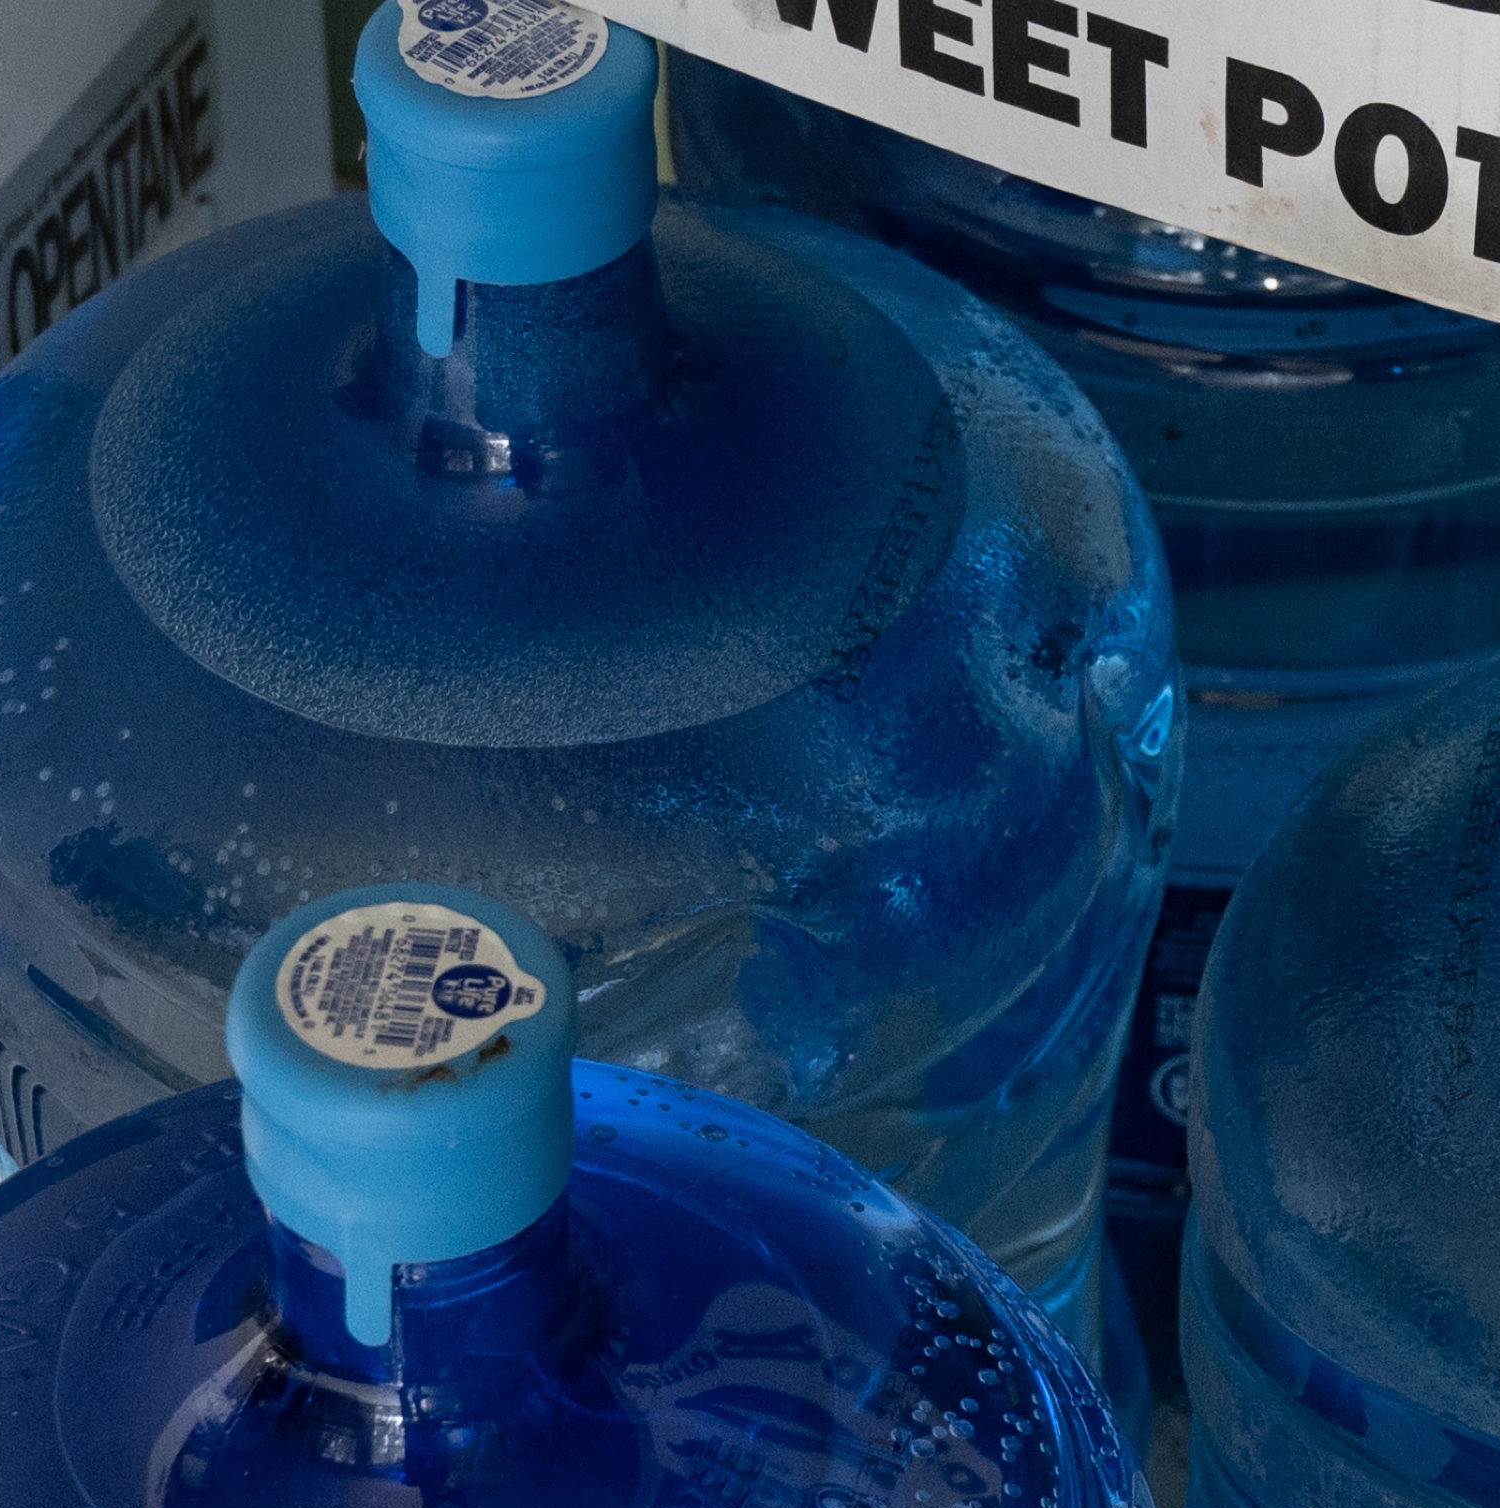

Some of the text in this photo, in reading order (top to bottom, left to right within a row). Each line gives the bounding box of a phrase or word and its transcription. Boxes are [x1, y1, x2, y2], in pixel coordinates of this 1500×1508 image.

[465, 10, 547, 68] 68274 36481
[457, 977, 482, 1011] Life
[479, 976, 507, 1014] Pure
